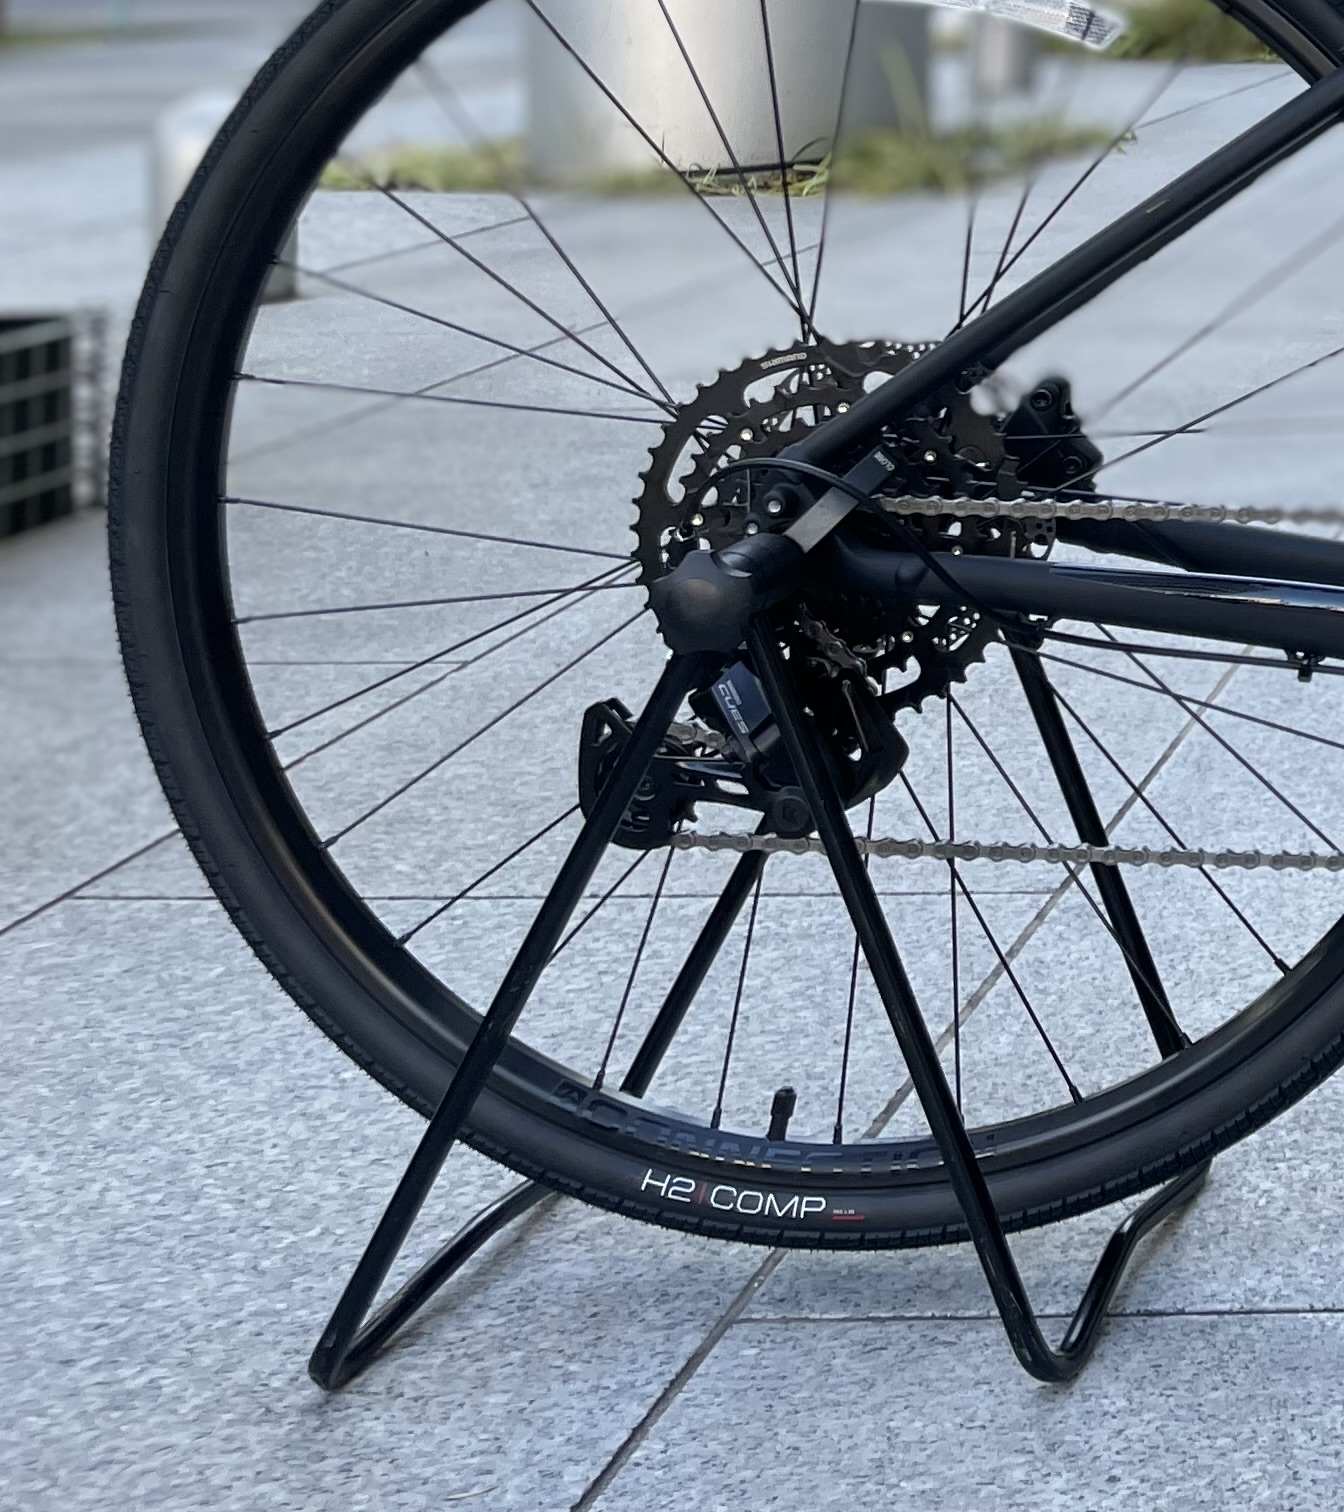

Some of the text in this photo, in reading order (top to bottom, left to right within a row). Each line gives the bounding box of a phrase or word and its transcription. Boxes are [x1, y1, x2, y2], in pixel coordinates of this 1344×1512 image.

[718, 683, 749, 734] CUES
[640, 1168, 827, 1219] H2 COMP
